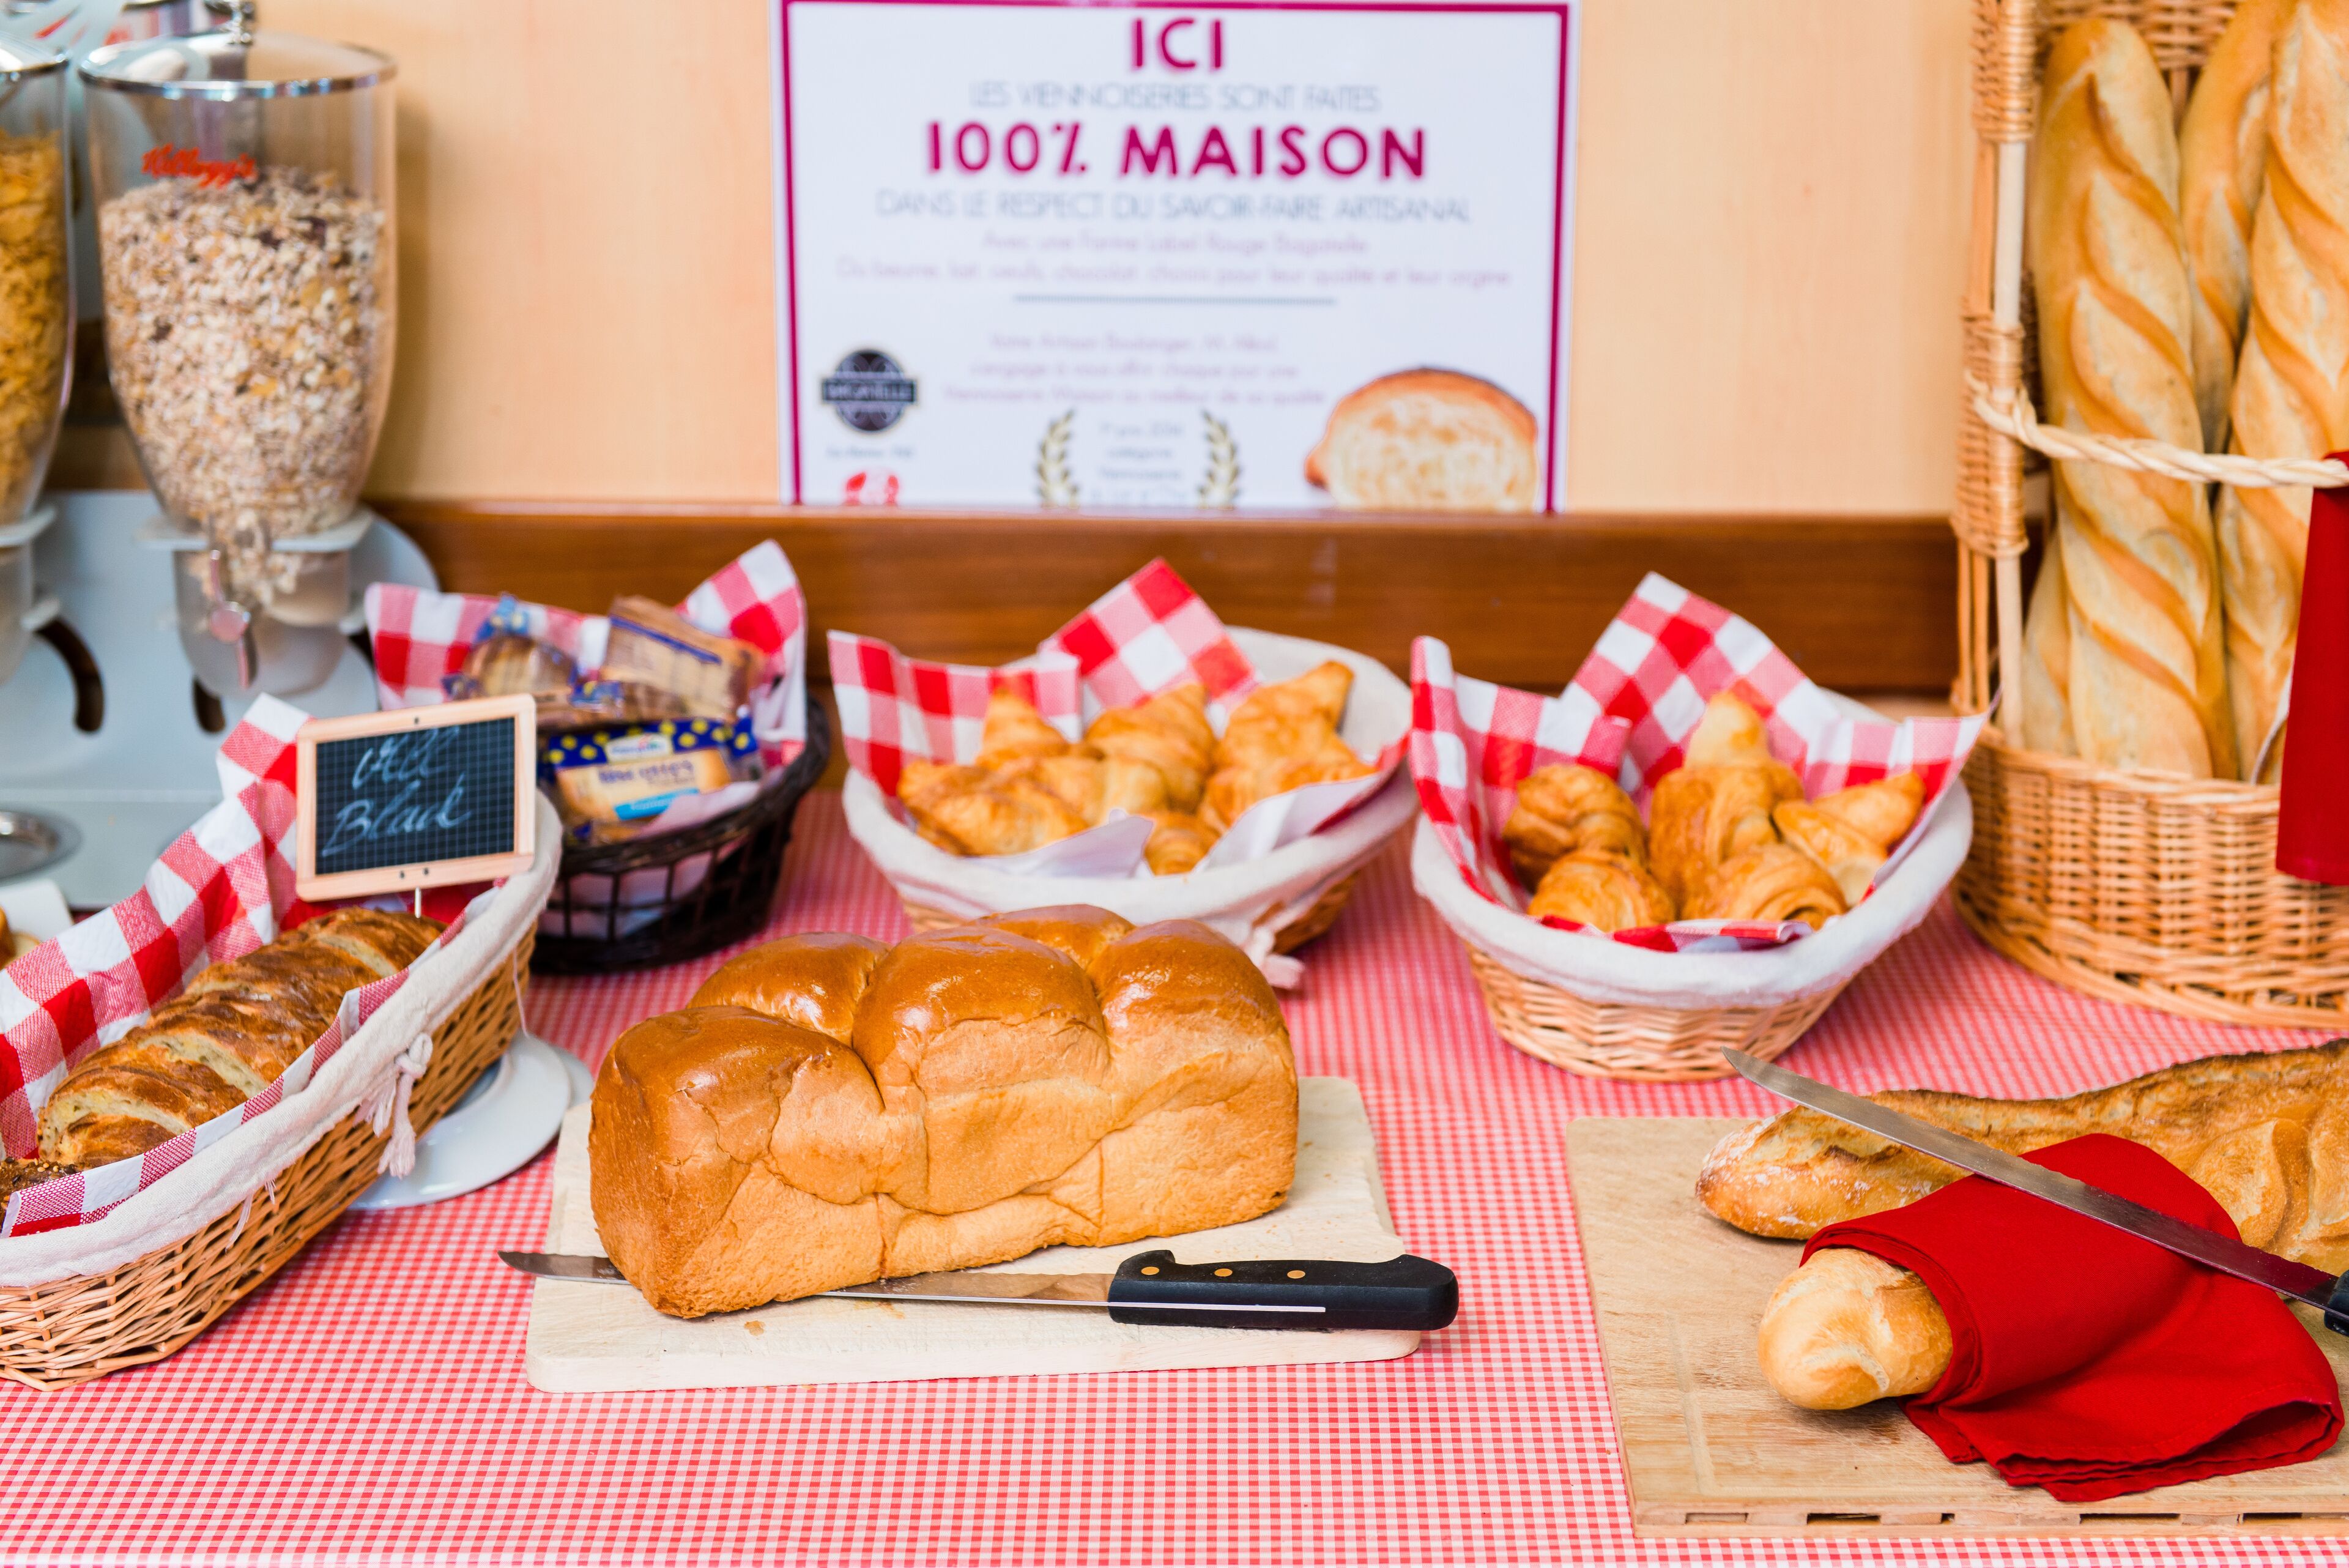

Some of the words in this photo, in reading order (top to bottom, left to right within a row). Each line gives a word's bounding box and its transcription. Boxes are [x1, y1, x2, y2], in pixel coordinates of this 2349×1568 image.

[1130, 16, 1225, 72] ICI
[970, 81, 1009, 109] LES
[1020, 82, 1210, 110] VIENNOISERIES
[1219, 83, 1294, 111] SONT
[1304, 84, 1380, 113] FAITES
[141, 143, 260, 188] Kellogg's
[926, 121, 1088, 174] 100%
[1119, 124, 1426, 180] MAISON
[875, 187, 955, 218] DANS
[962, 188, 987, 220] LE
[995, 189, 1104, 220] RESPECT
[1111, 192, 1153, 221] DU
[1160, 193, 1325, 222] SAVOIR-FAIRE
[1336, 195, 1470, 224] ARTISANAL
